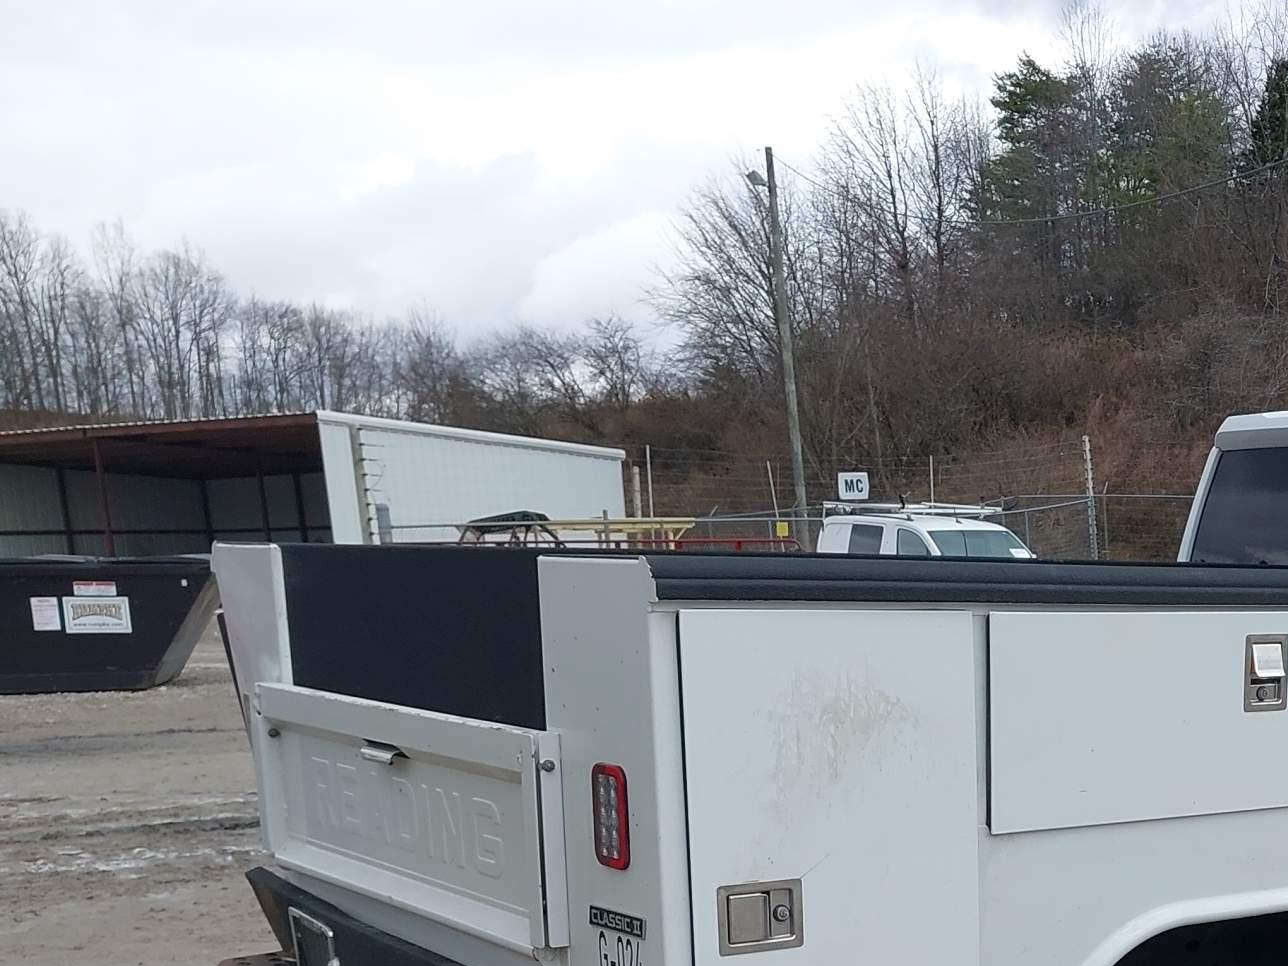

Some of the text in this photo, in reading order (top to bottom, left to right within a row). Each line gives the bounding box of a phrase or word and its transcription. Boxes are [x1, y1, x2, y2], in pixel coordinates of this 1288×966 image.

[844, 479, 864, 494] MC
[309, 755, 506, 880] READING
[591, 908, 632, 932] CLASSIC
